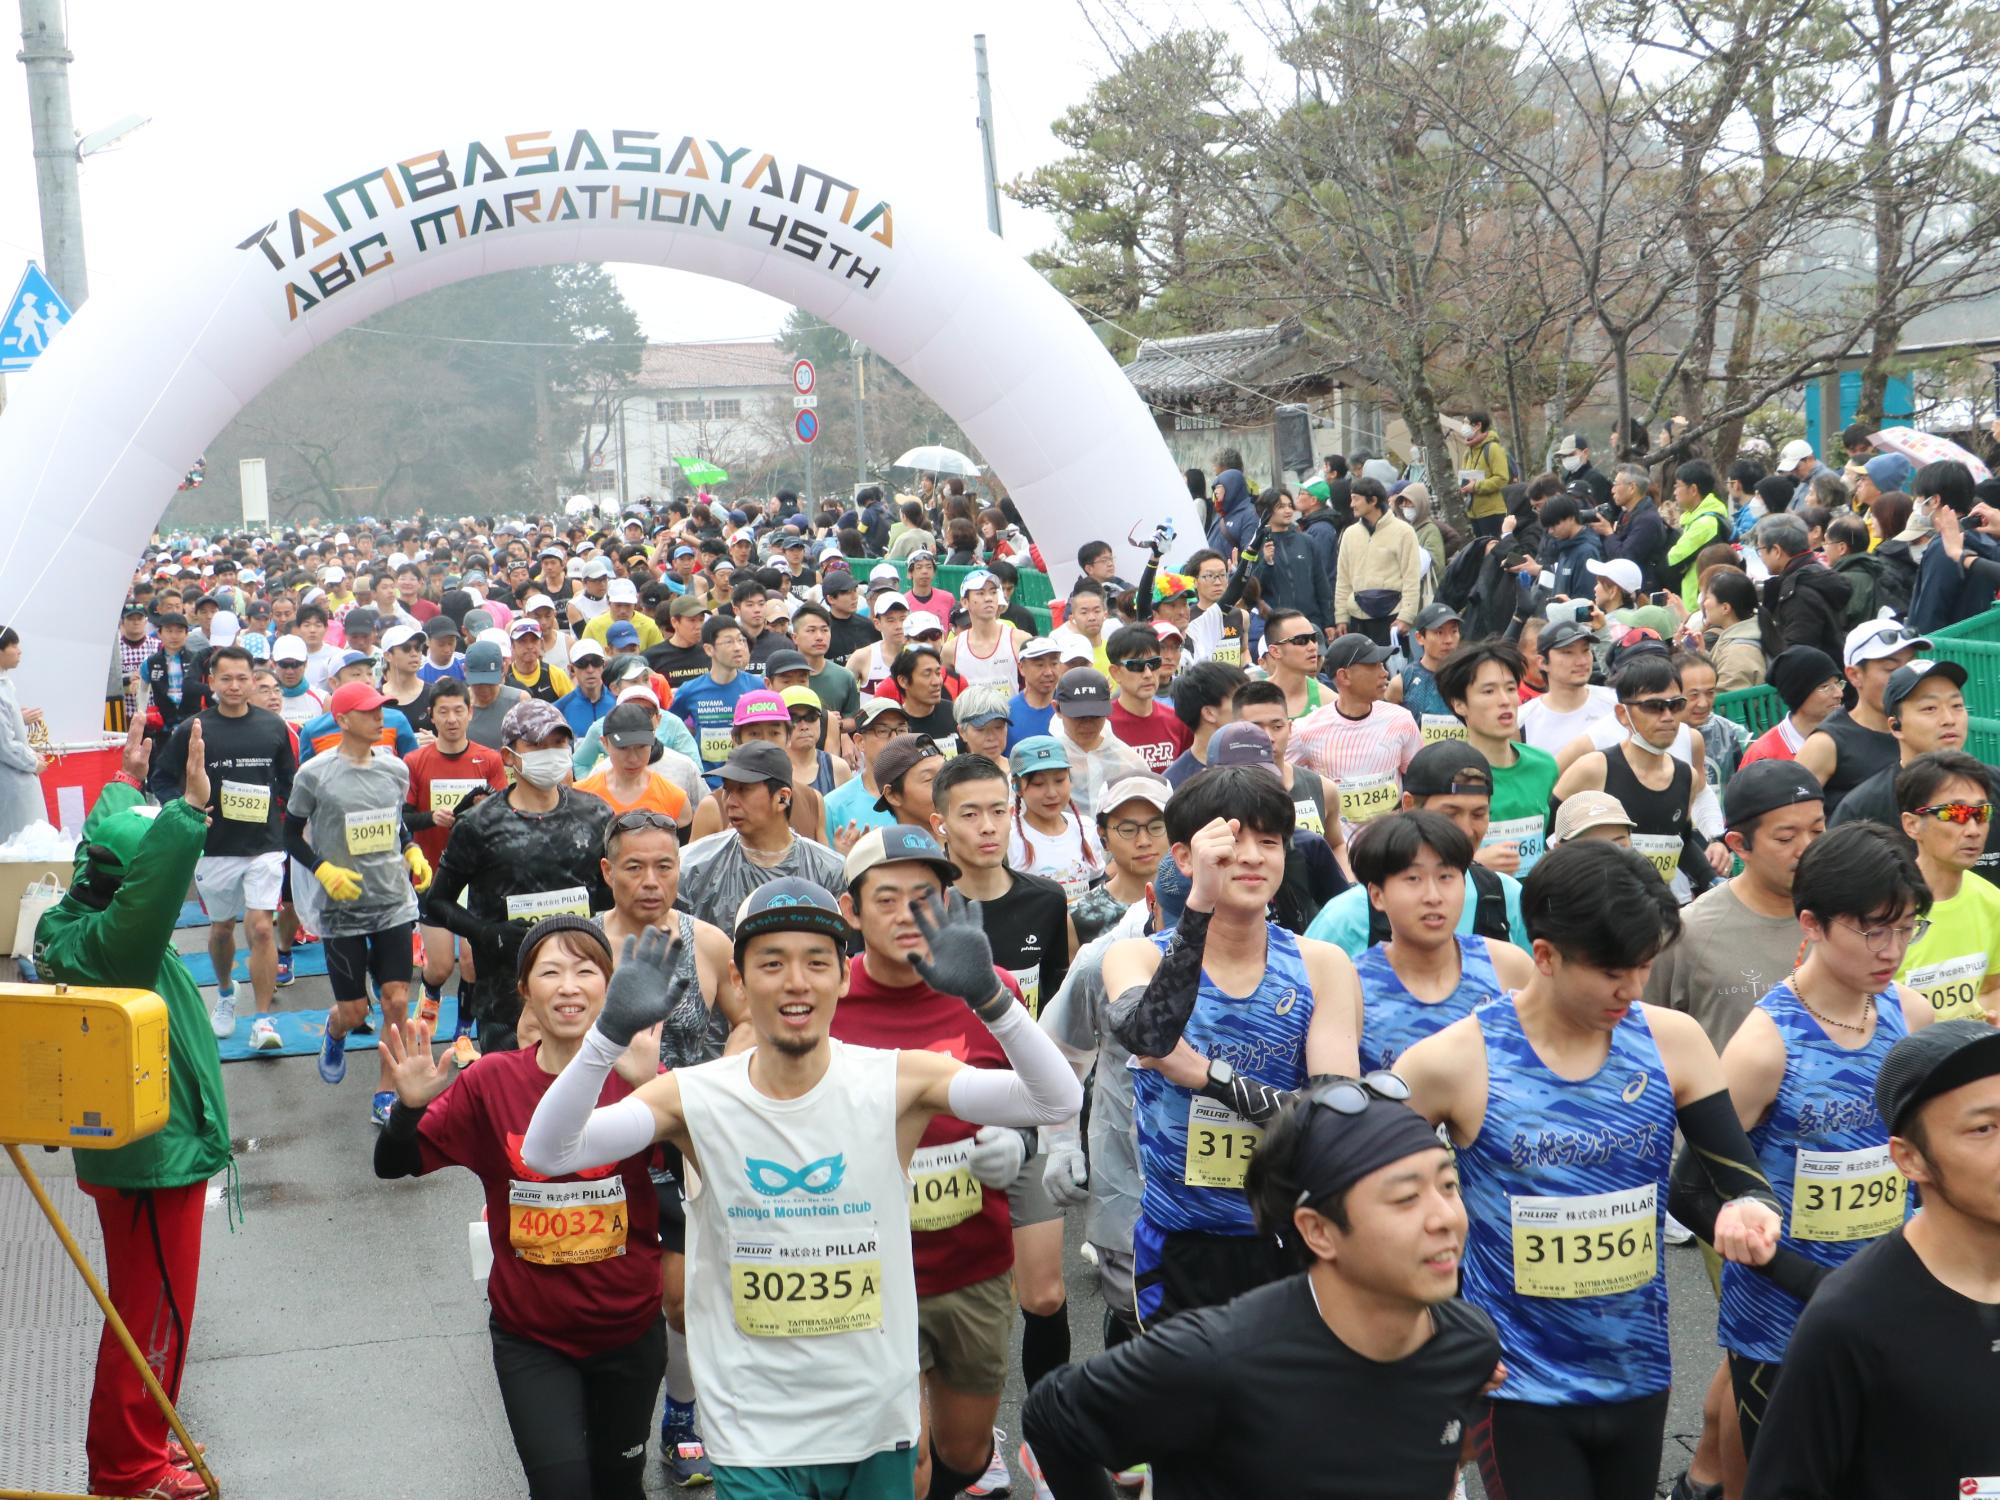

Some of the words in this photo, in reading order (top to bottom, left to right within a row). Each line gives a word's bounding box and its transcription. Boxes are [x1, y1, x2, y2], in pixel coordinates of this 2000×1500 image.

[236, 129, 893, 270] TAMBASASAYAMA
[285, 232, 394, 321] ABC
[411, 184, 732, 252] MARATHON
[748, 206, 880, 289] 45TH
[697, 700, 724, 708] TOYAMA
[697, 707, 733, 715] MARATHON
[746, 702, 778, 714] HOKA
[705, 740, 735, 752] 3064
[223, 794, 261, 810] 35582
[435, 794, 460, 806] 307
[1343, 787, 1389, 808] 31284
[1391, 791, 1398, 799] A
[351, 824, 392, 841] 30941
[561, 894, 588, 904] PILLAR
[1195, 1108, 1230, 1119] PILLAR
[1198, 1130, 1257, 1160] 313
[1512, 1124, 1657, 1169] 多紀ランナーズ
[936, 1152, 968, 1167] PILLA
[1802, 1162, 1840, 1172] PILLAR
[1845, 1158, 1880, 1172] 株式会社
[513, 1190, 541, 1201] PILLAR
[546, 1191, 579, 1202] 株式会社
[581, 1186, 624, 1201] PILLAR
[913, 1175, 961, 1205] 104
[966, 1181, 977, 1197] A
[1805, 1175, 1898, 1212] 31298
[727, 1205, 771, 1221] Shioya
[774, 1203, 839, 1217] Mountain
[842, 1200, 872, 1215] Club
[1518, 1210, 1558, 1221] PILLAR
[1565, 1207, 1608, 1221] 株式会社
[1611, 1196, 1655, 1218] PILLAR
[516, 1209, 606, 1239] 40032
[611, 1212, 624, 1233] A
[735, 1246, 773, 1256] PILLAR
[779, 1246, 821, 1259] 株式会社
[825, 1240, 877, 1257] PILLAR
[1525, 1227, 1637, 1264] 31356
[1641, 1237, 1653, 1255] A
[742, 1269, 853, 1302] 30235
[861, 1275, 875, 1297] A
[787, 1313, 872, 1327] TAMBASASAYAMA
[787, 1326, 804, 1335] ABC
[806, 1323, 851, 1334] MARATHON
